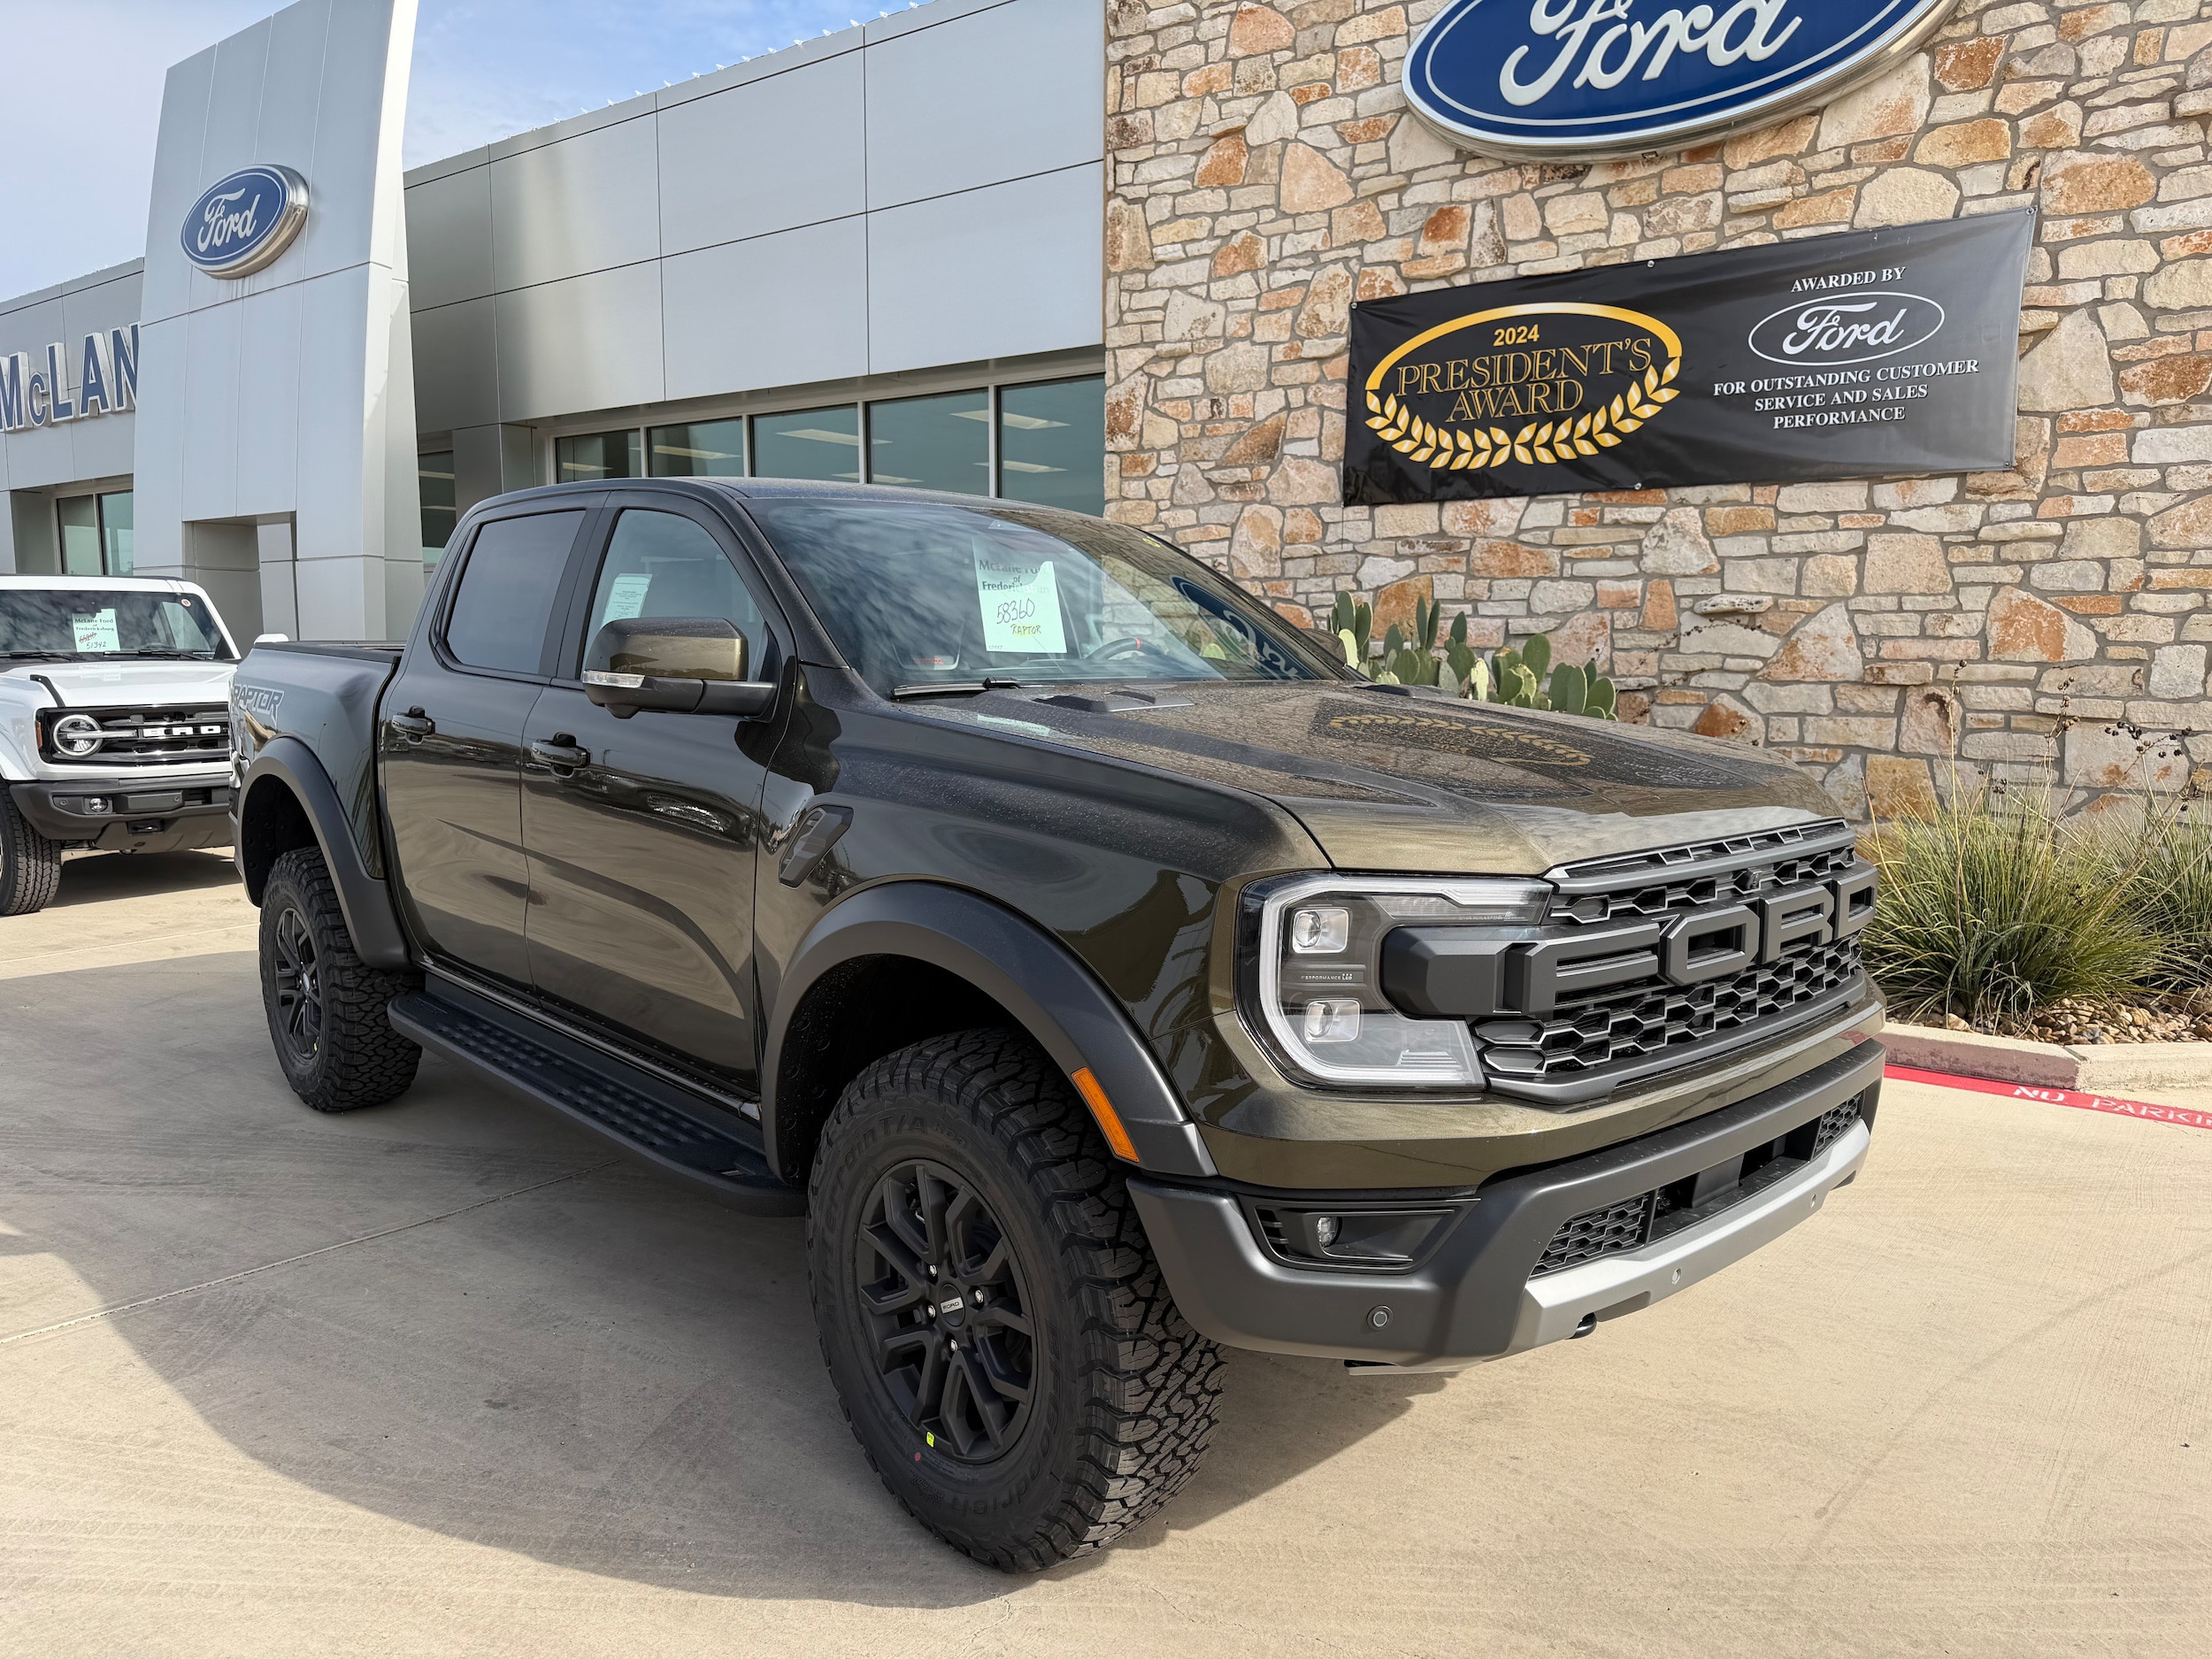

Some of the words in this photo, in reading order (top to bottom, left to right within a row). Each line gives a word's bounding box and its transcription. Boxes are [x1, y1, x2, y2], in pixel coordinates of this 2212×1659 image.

[1500, 0, 1802, 106] Ford
[197, 188, 260, 252] Ford
[1791, 270, 1877, 293] AWARDED
[1881, 266, 1906, 282] BY
[1494, 324, 1540, 347] 2024
[1782, 302, 1907, 355] Ford
[1396, 338, 1652, 397] PRESIDENT'S
[1713, 381, 1746, 396] FOR
[1750, 369, 1871, 393] OUTSTANDING
[1876, 359, 1979, 380] CUSTOMER
[1445, 379, 1584, 423] AWARD
[1755, 393, 1826, 412] SERVICE
[1832, 389, 1867, 405] AND
[1871, 383, 1928, 403] SALES
[1773, 406, 1906, 429] PERFORMANCE
[996, 597, 1035, 624] 58360
[1010, 623, 1041, 635] RAPTOR
[86, 641, 106, 649] 51342
[233, 684, 285, 729] RAPTOR
[1524, 864, 1878, 1015] FORD
